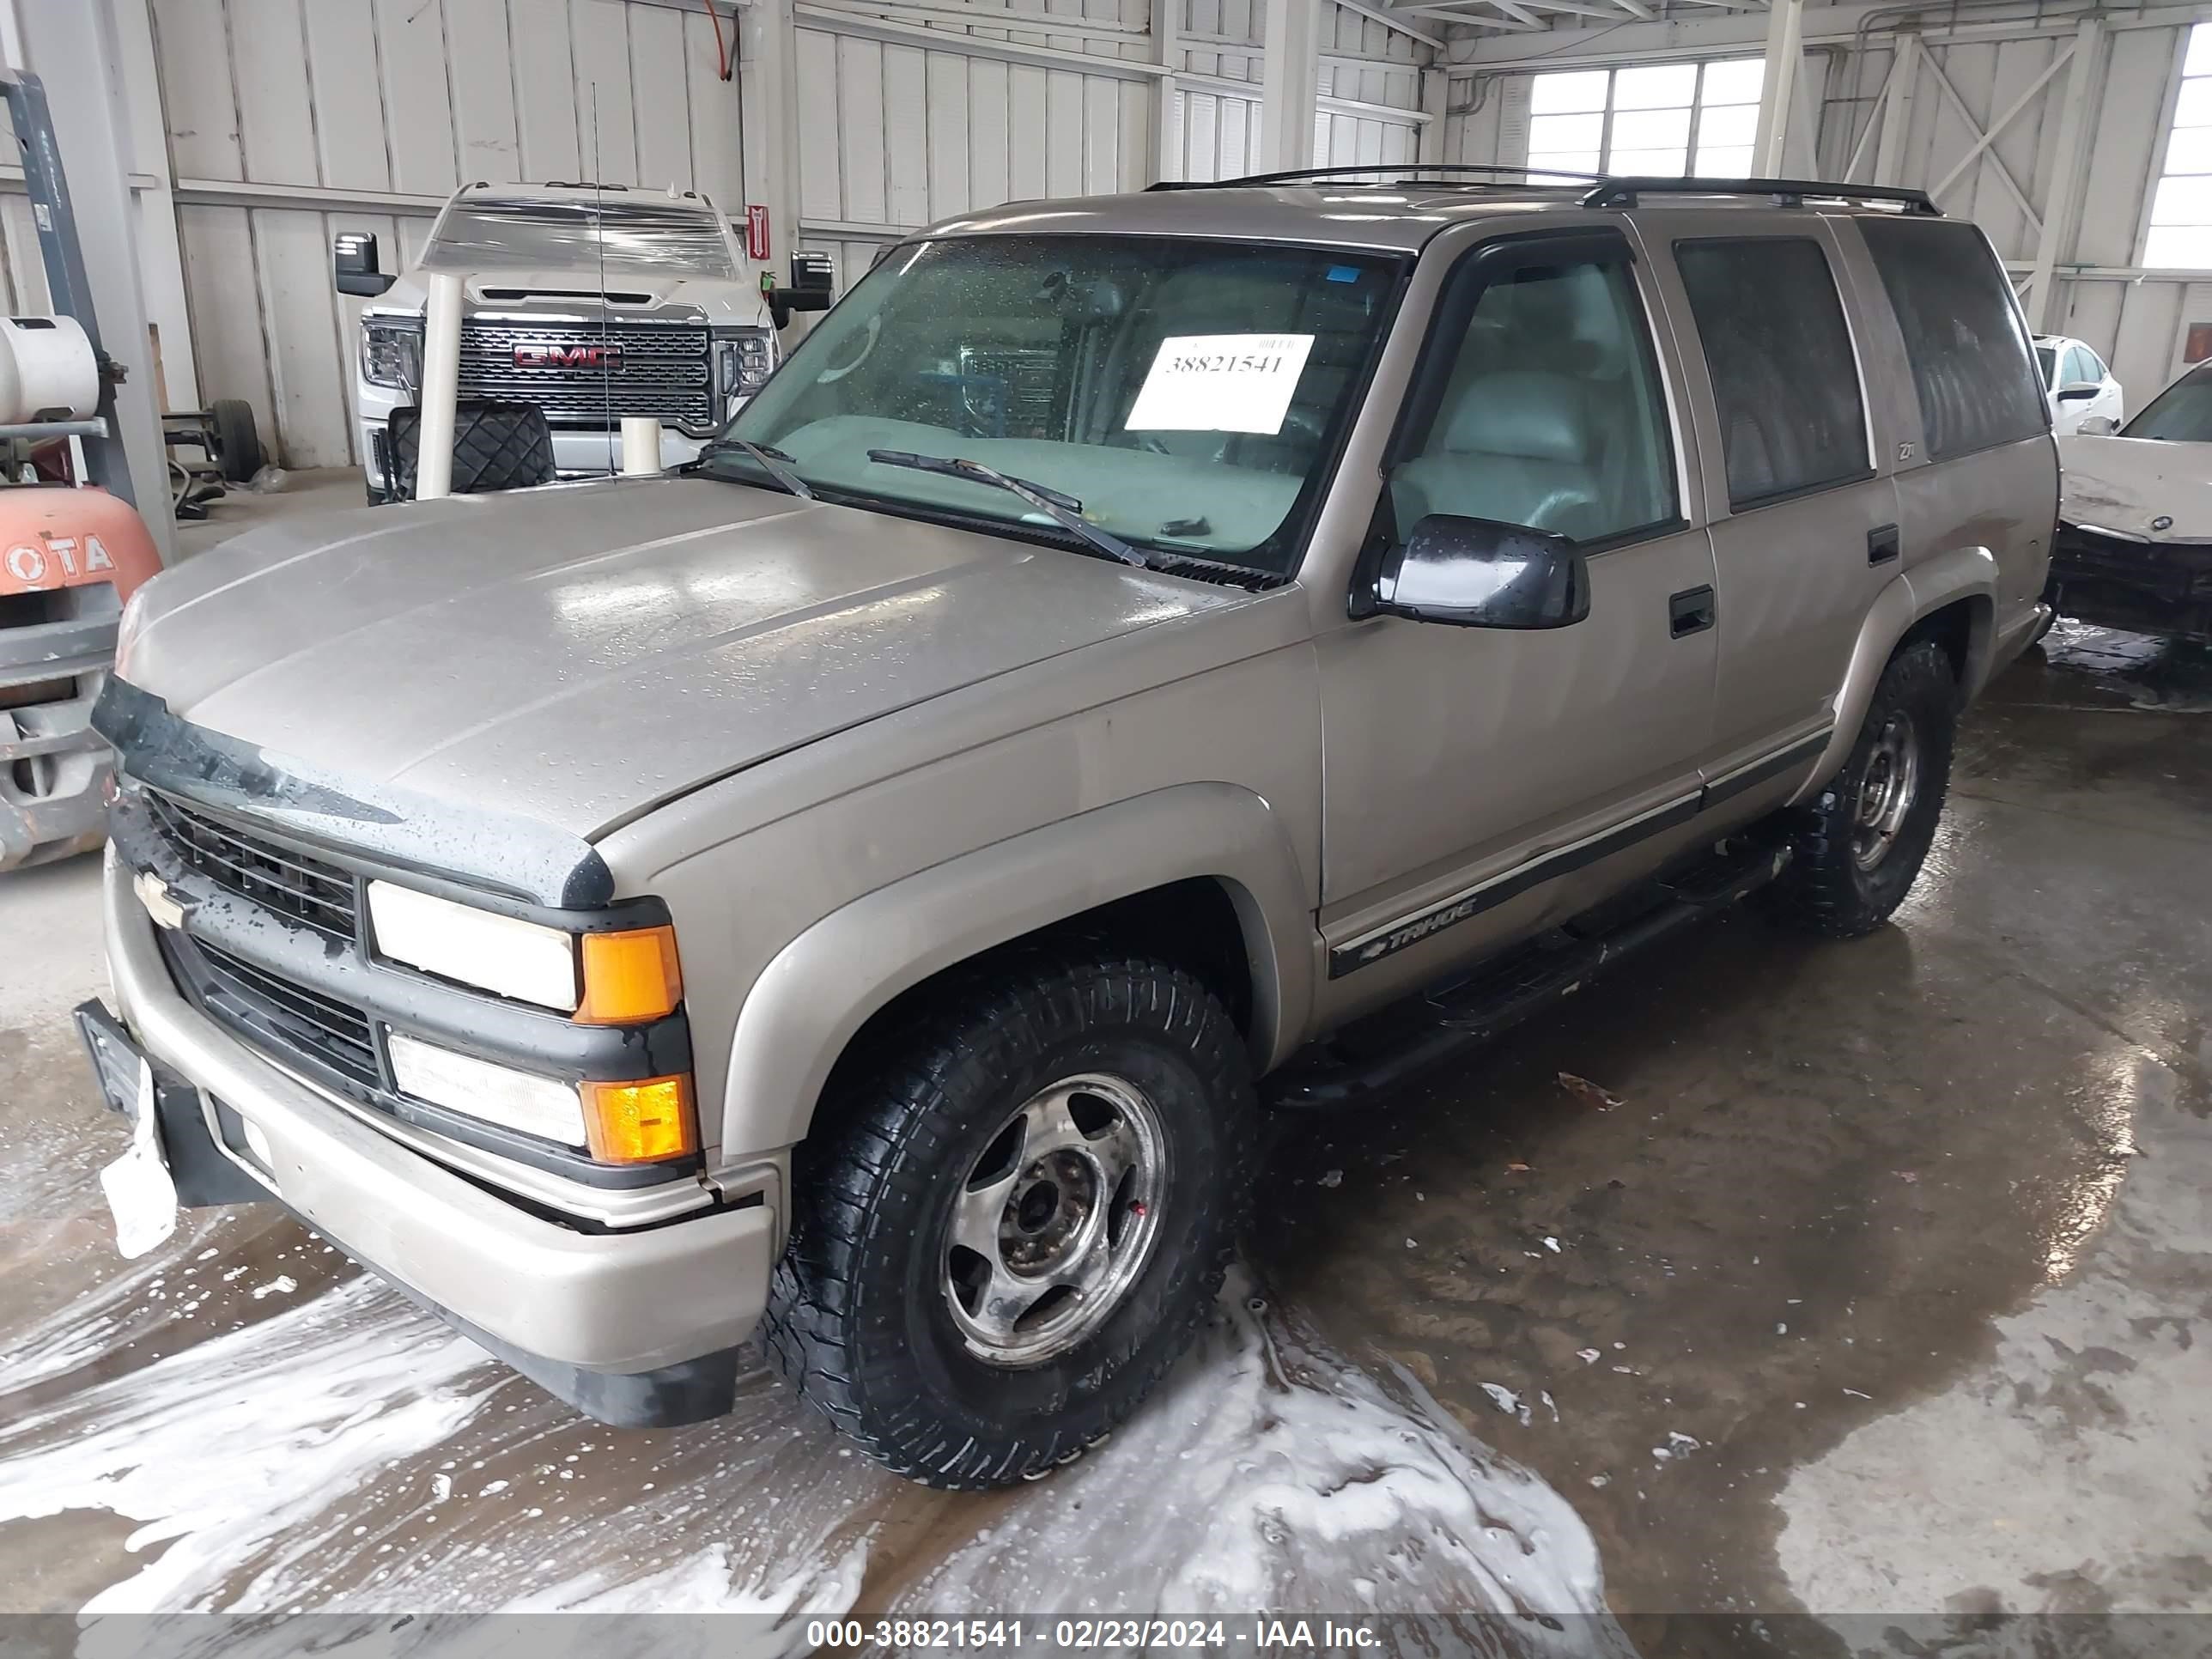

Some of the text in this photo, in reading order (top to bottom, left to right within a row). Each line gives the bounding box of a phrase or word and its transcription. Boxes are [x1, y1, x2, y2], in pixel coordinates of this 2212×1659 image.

[514, 345, 621, 367] GMC
[1165, 356, 1282, 374] 38821541
[4, 534, 116, 581] OTA
[1389, 898, 1477, 948] TAHOE
